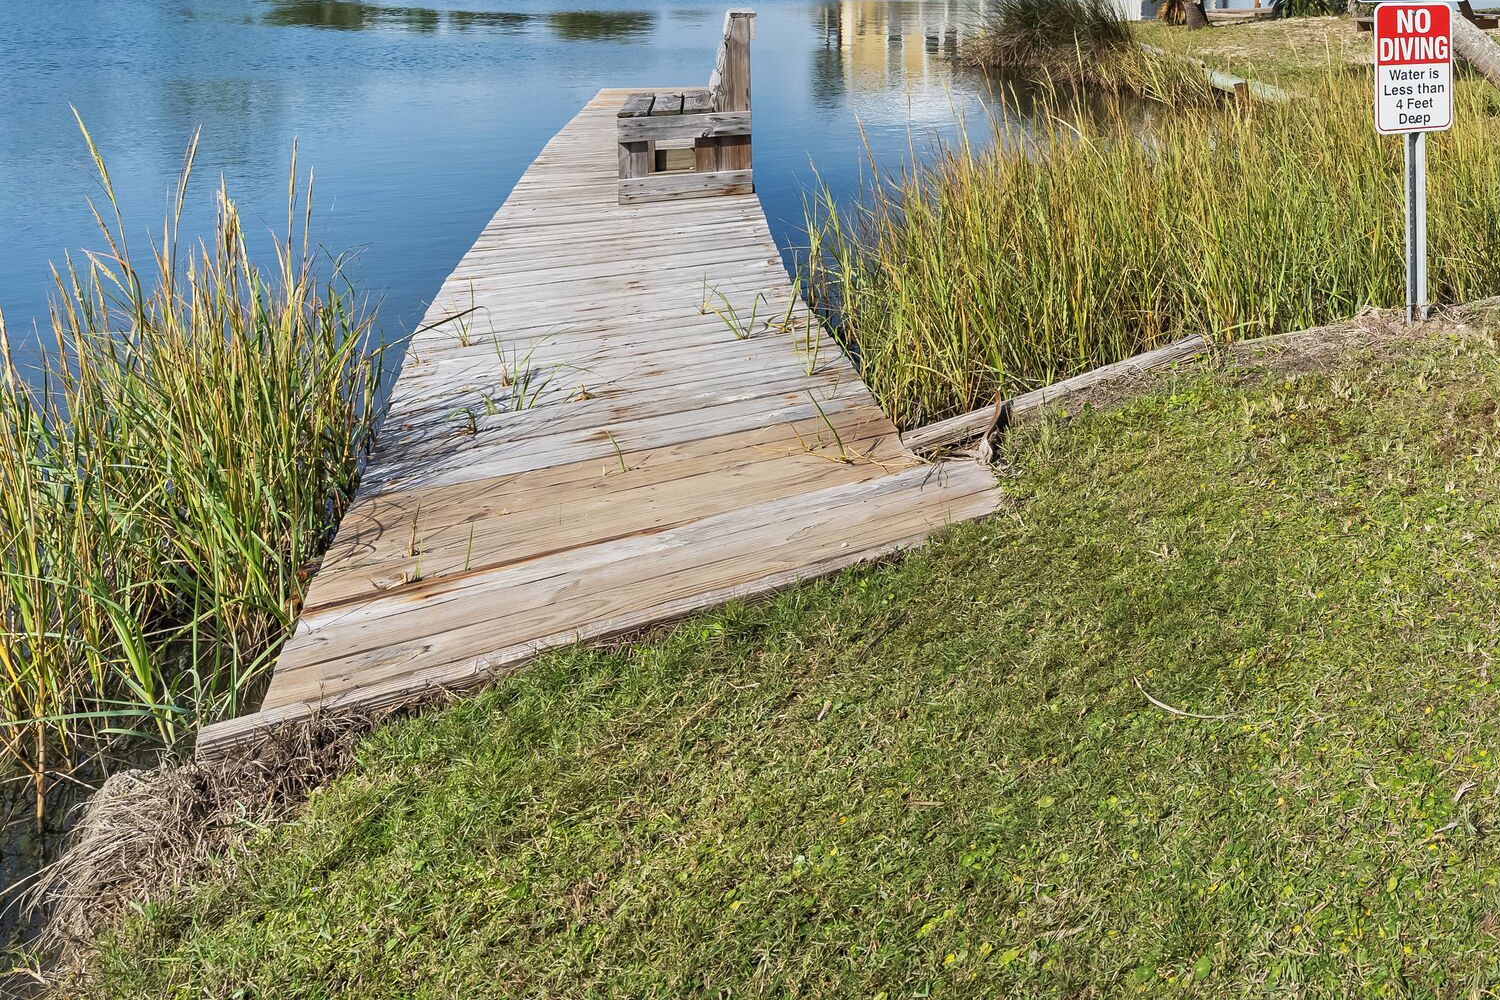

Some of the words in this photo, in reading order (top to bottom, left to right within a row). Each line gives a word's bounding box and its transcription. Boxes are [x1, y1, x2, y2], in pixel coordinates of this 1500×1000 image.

[1396, 8, 1431, 34] NO
[1379, 35, 1448, 62] DIVING
[1389, 69, 1425, 81] Water
[1429, 68, 1439, 79] is
[1384, 84, 1413, 96] Less
[1417, 83, 1445, 94] than
[1396, 99, 1404, 110] 4
[1407, 97, 1433, 109] Feet
[1399, 113, 1431, 126] Deep
